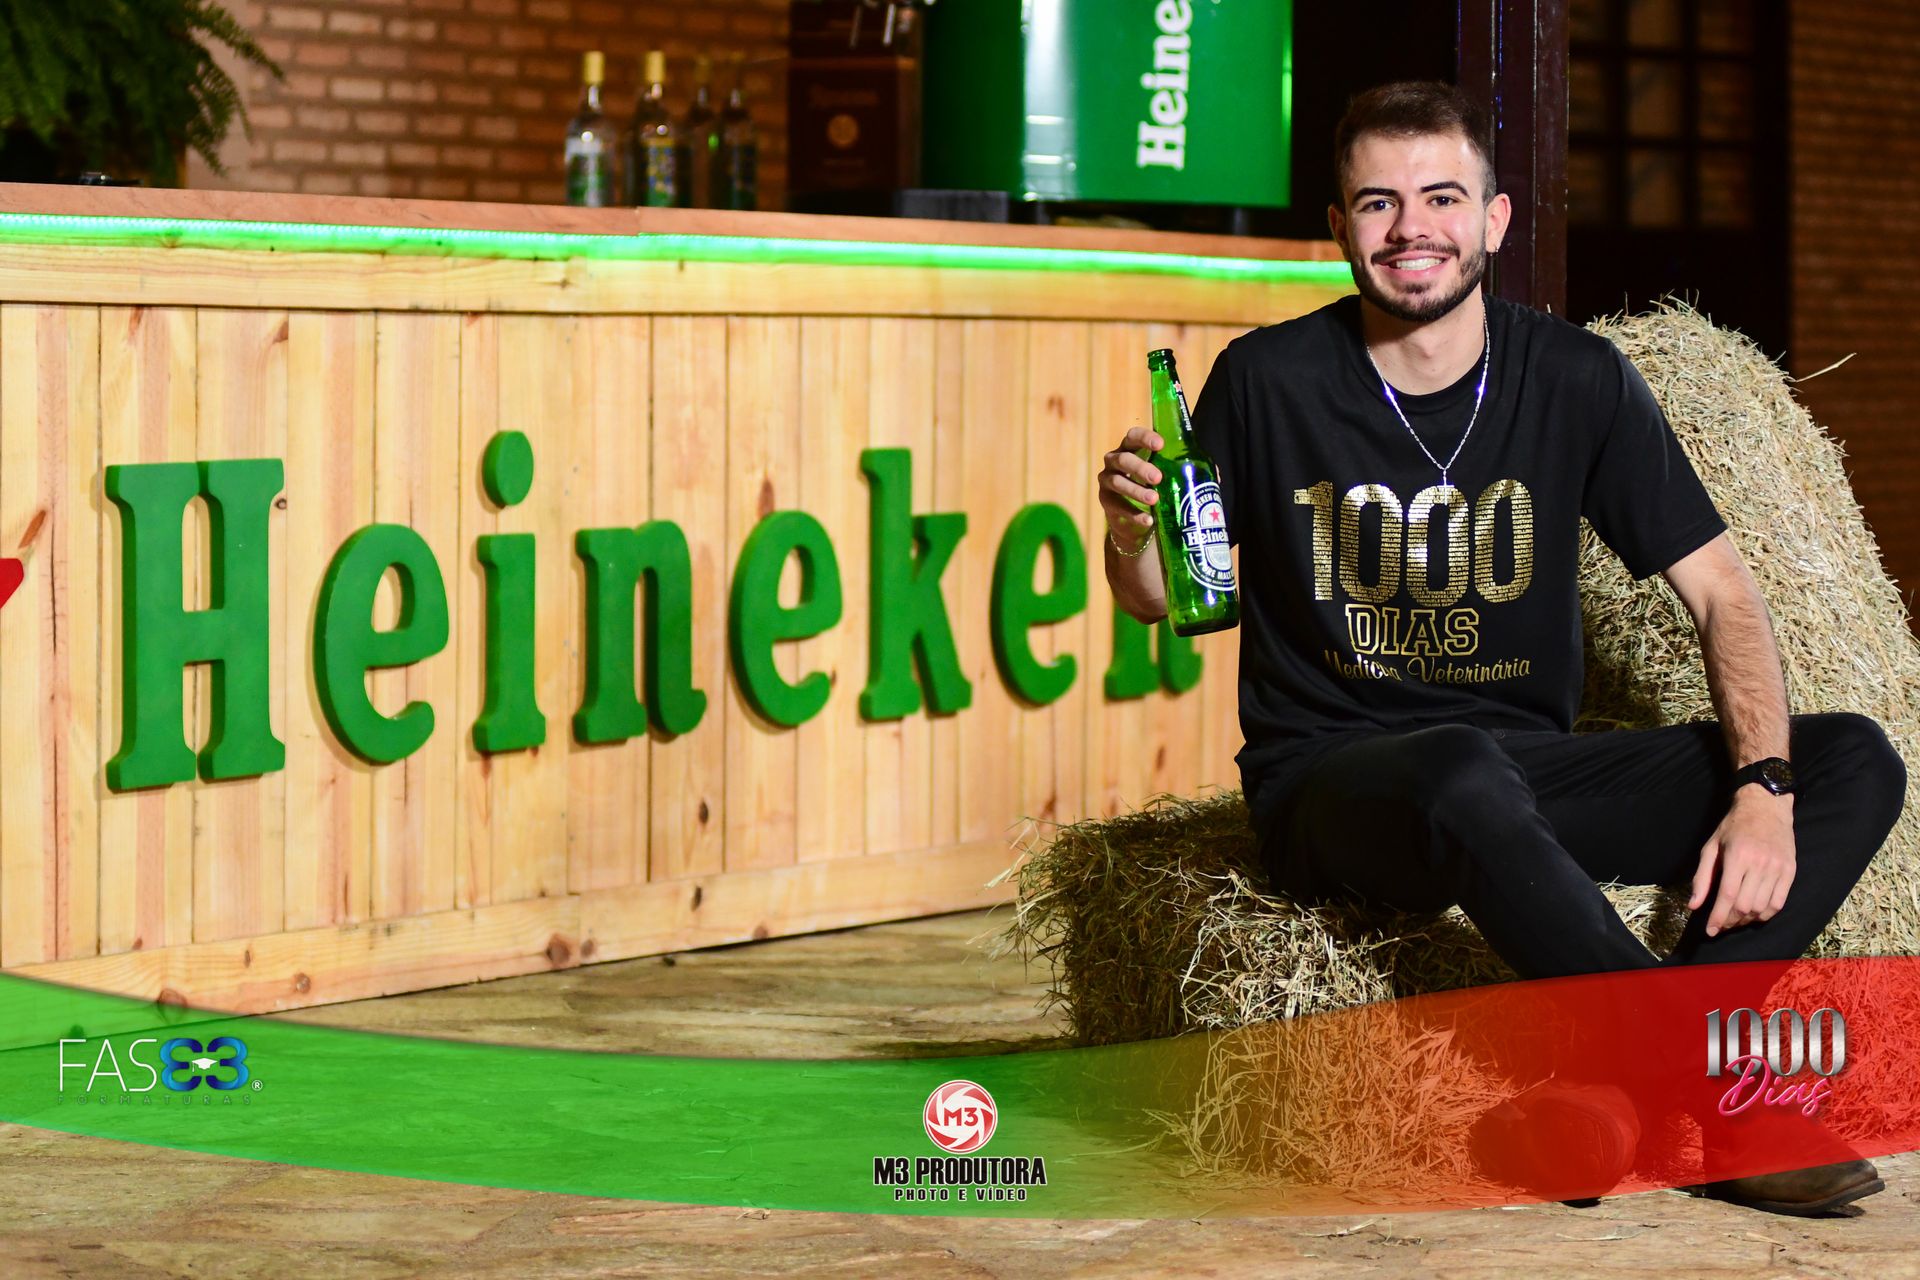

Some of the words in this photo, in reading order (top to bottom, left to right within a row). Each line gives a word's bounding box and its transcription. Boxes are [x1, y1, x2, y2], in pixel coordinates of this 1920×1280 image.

[1294, 479, 1534, 607] 1000
[1345, 604, 1479, 656] DIAS
[1407, 656, 1531, 685] Veterinária
